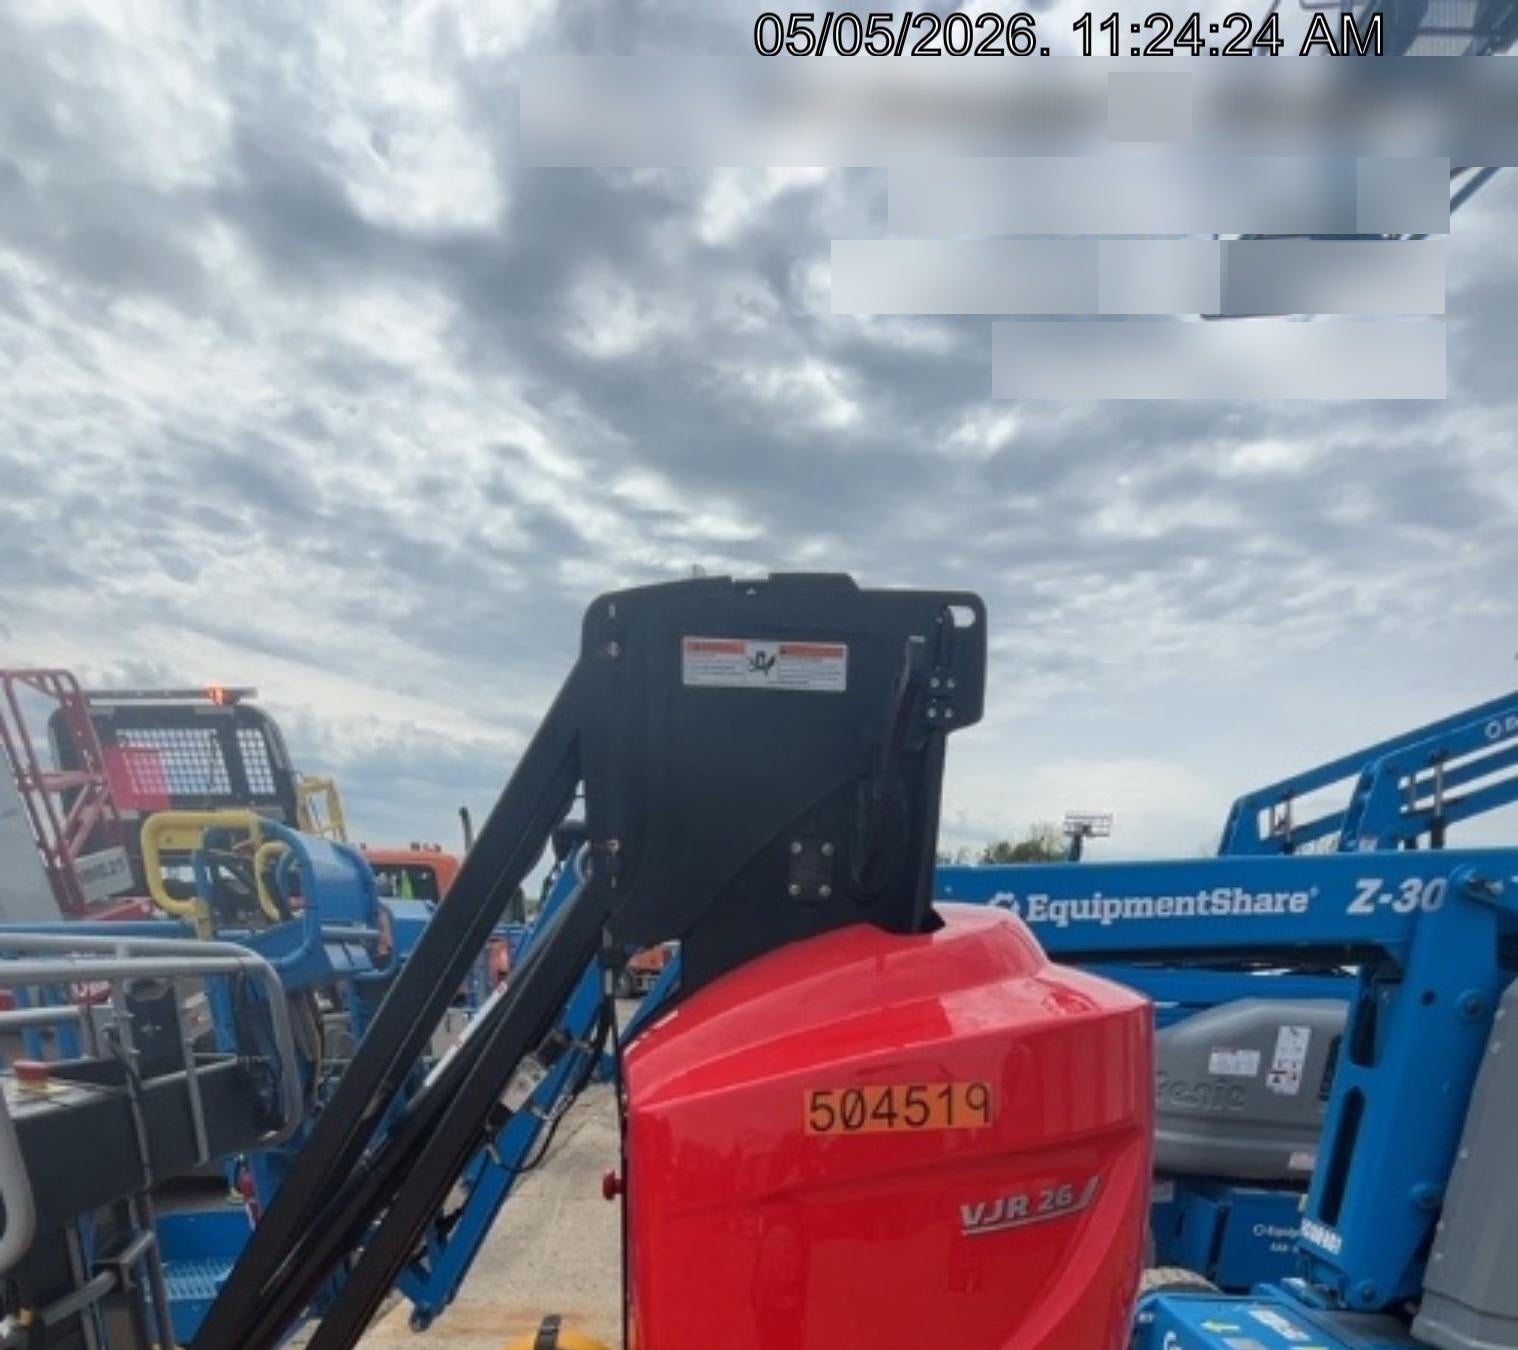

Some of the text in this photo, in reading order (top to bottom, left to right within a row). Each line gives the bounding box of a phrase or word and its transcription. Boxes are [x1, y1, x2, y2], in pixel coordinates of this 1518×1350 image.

[1026, 877, 1447, 927] EquipmentShare Z-30
[809, 1083, 990, 1132] 504519
[960, 1184, 1073, 1227] VJR 26
